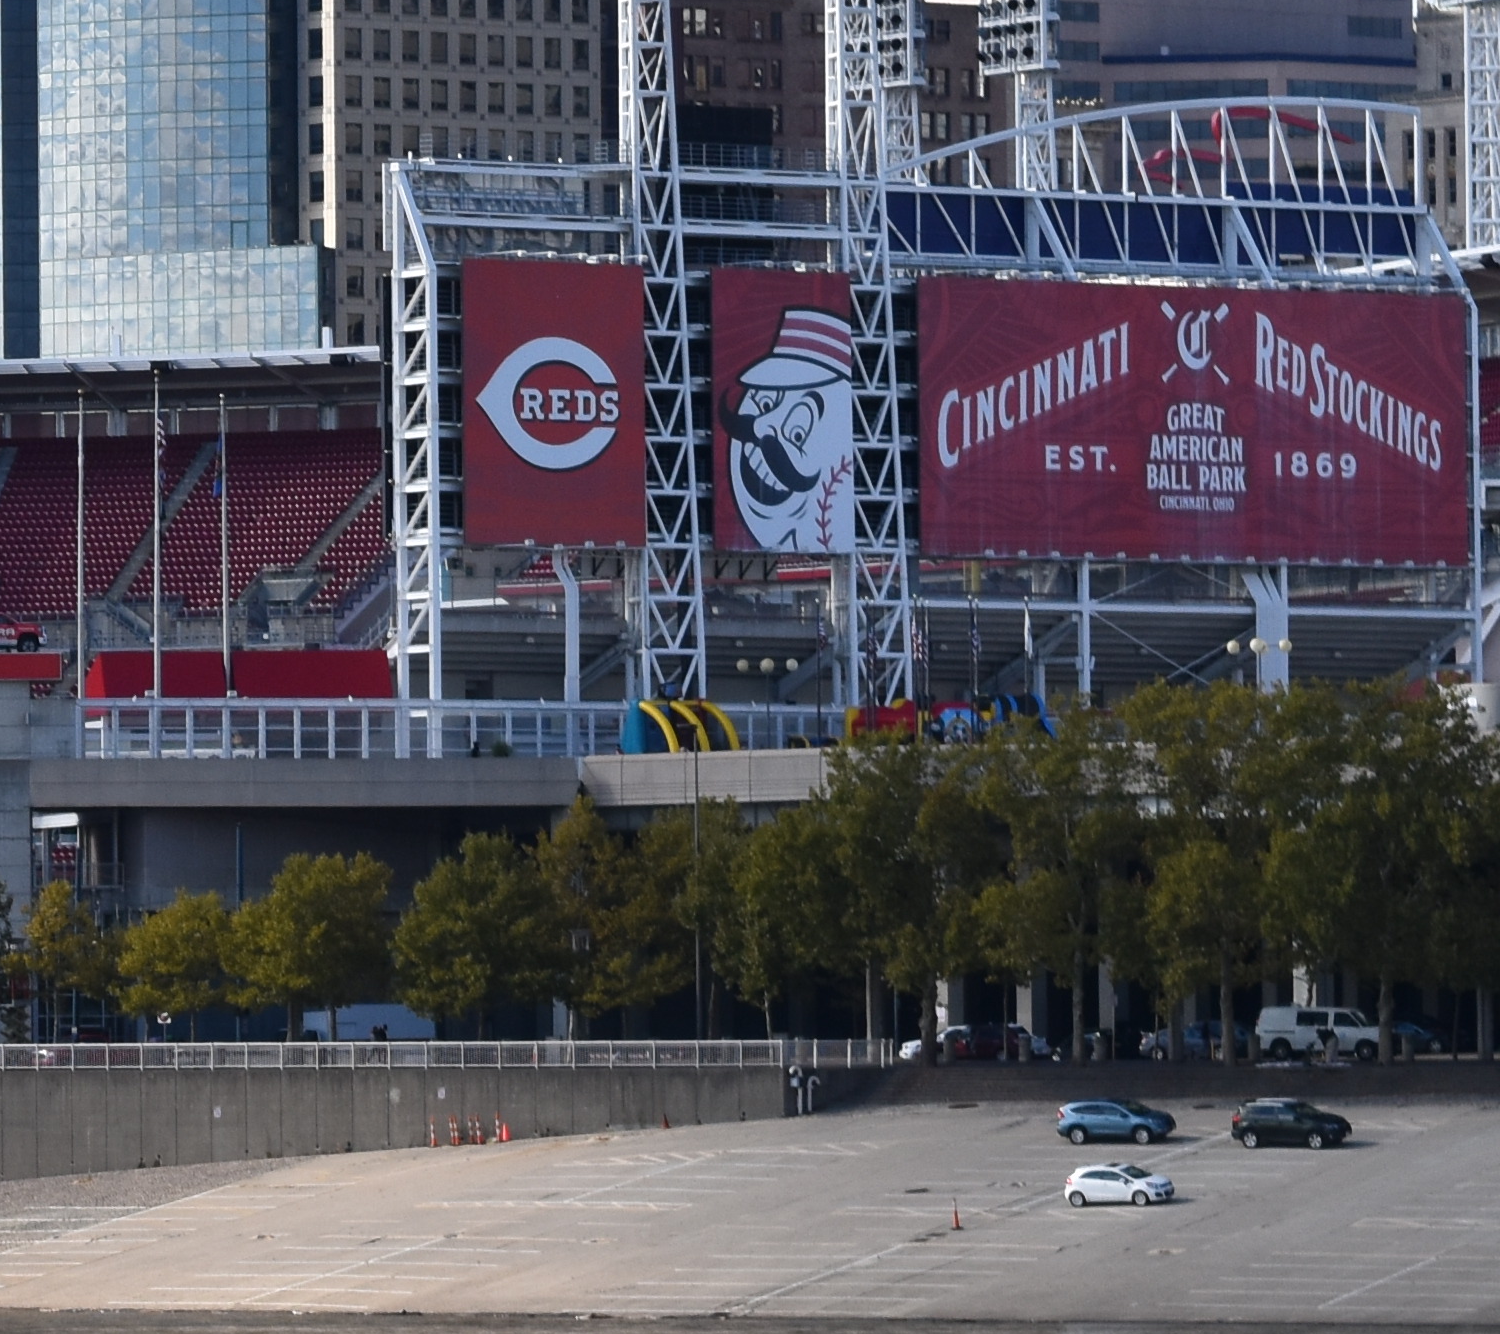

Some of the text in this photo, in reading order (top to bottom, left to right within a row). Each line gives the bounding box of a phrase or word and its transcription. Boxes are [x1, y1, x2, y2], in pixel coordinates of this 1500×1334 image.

[520, 388, 619, 422] REDS
[1167, 403, 1225, 433] GREAT
[1045, 444, 1116, 472] EST.
[1150, 434, 1244, 463] AMERICAN
[1146, 463, 1247, 492] BALL PARK
[1274, 451, 1357, 478] 1869
[1213, 496, 1235, 513] OHIO
